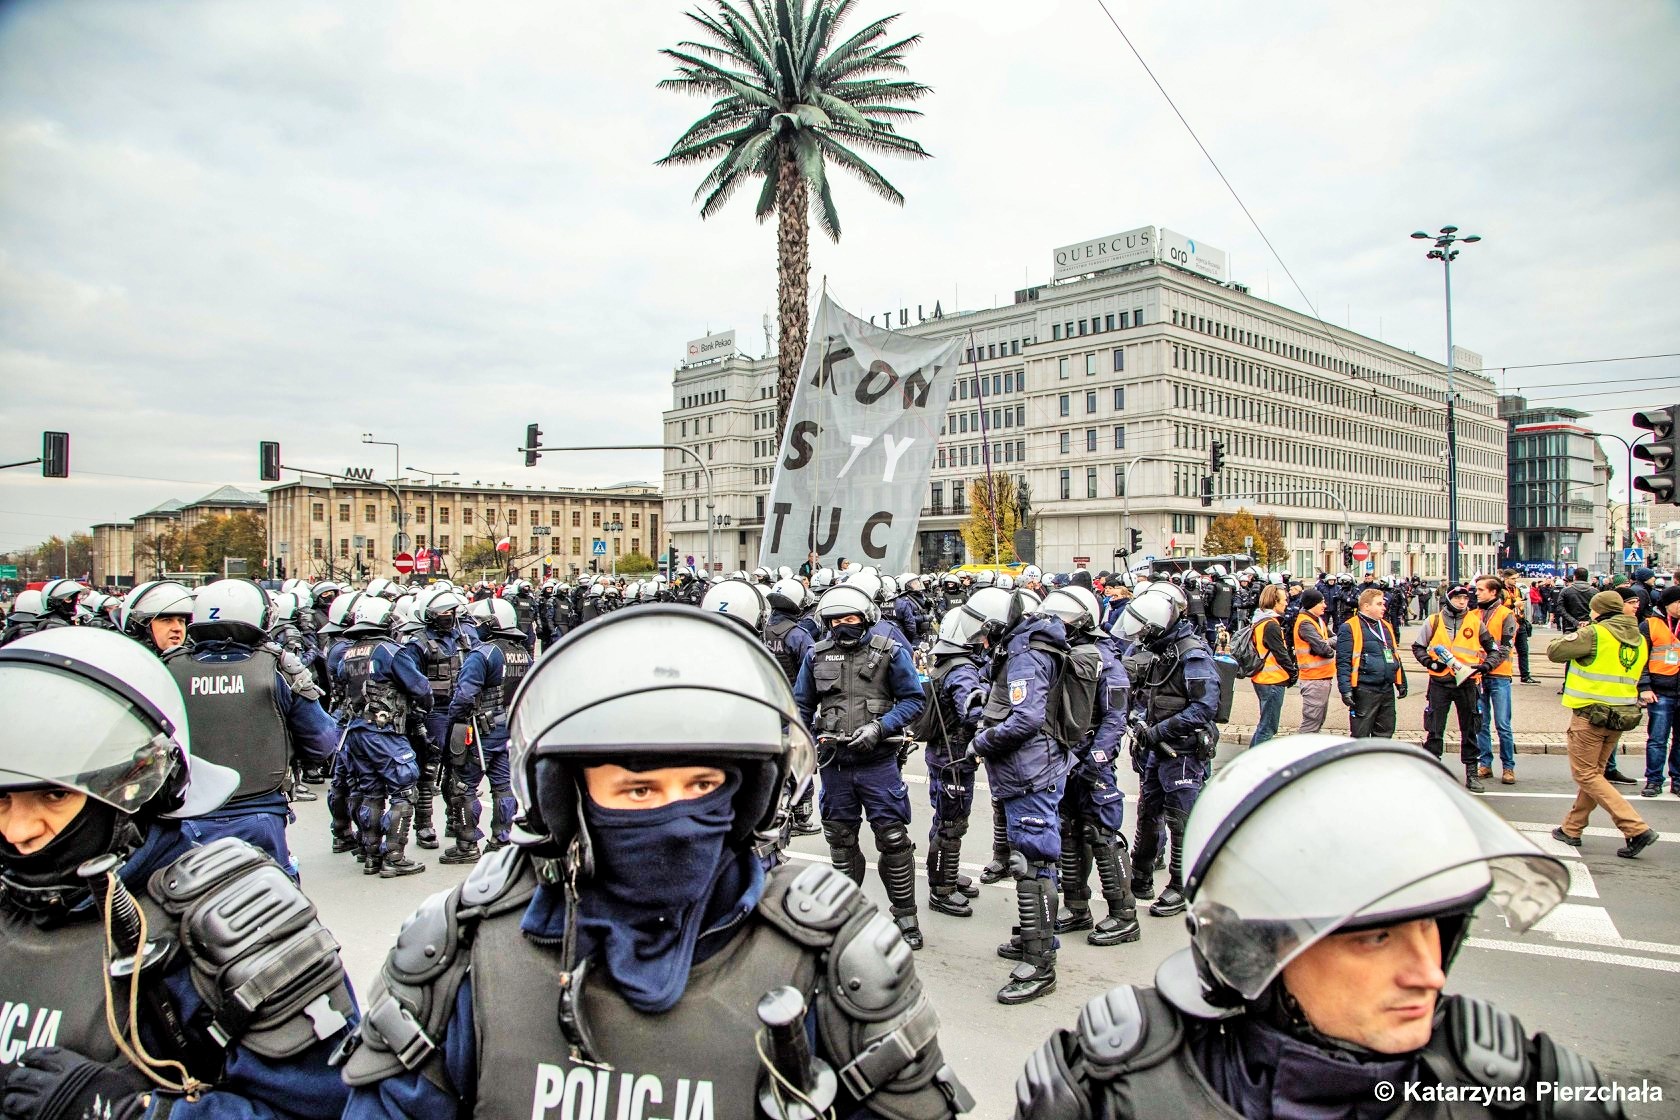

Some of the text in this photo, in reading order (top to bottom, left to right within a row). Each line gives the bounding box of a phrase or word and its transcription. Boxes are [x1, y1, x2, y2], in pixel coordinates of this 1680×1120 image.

[1056, 232, 1149, 265] QUERCUS
[1170, 247, 1188, 266] arp
[701, 338, 732, 352] Bank Pekao
[770, 502, 894, 559] TUC
[209, 607, 220, 619] Z
[719, 601, 729, 612] Z
[506, 651, 529, 664] POLICJA
[825, 654, 845, 662] POLICJA
[190, 675, 245, 696] POLICJA
[531, 1062, 714, 1120] POLICJA
